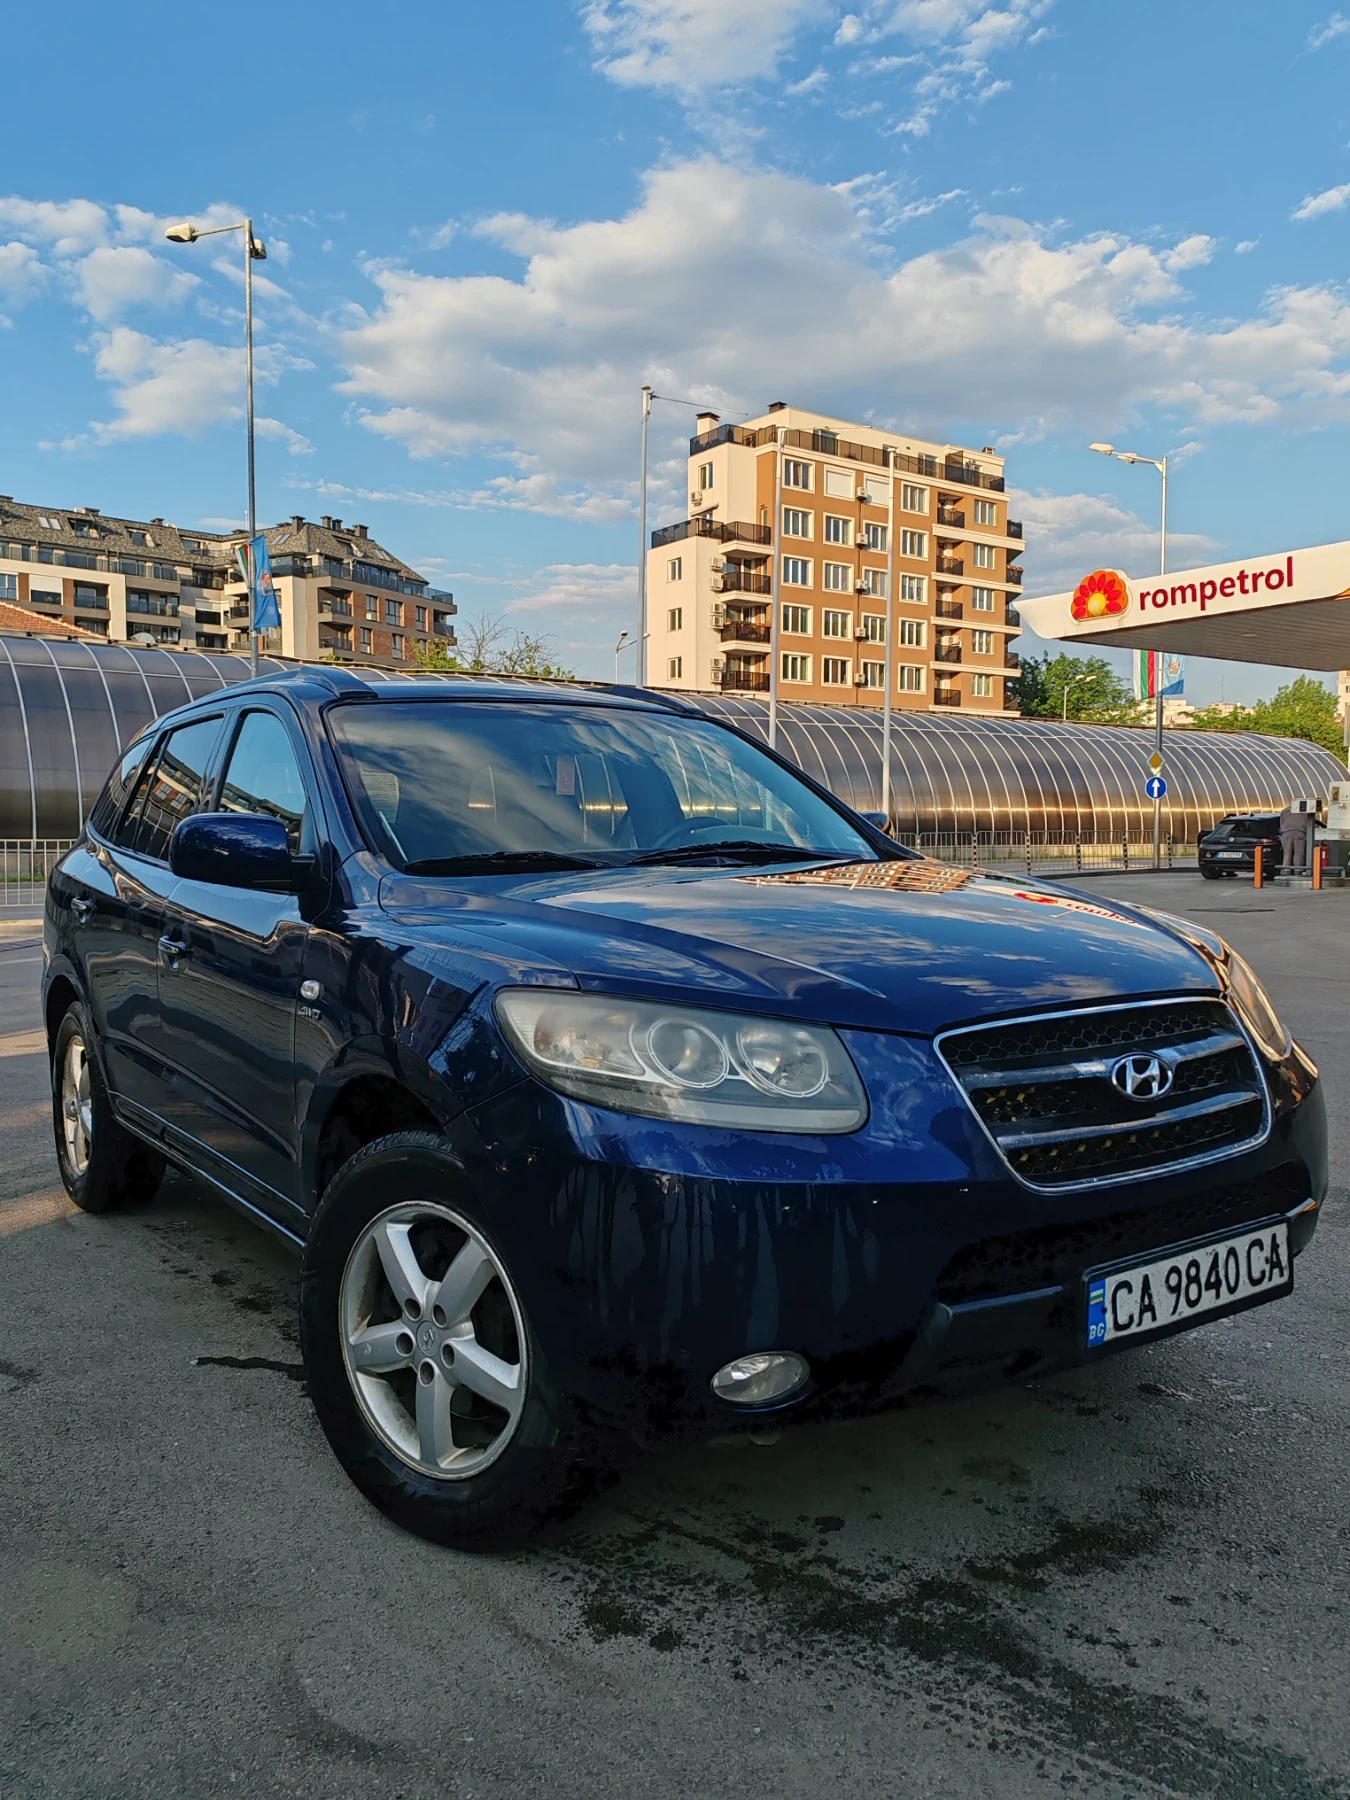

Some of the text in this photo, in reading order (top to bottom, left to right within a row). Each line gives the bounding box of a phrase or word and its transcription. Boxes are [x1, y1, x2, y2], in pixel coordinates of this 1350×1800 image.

[1140, 556, 1293, 611] rompetrol
[1111, 1233, 1284, 1332] CA 9840 CA
[1089, 1322, 1105, 1340] BG
